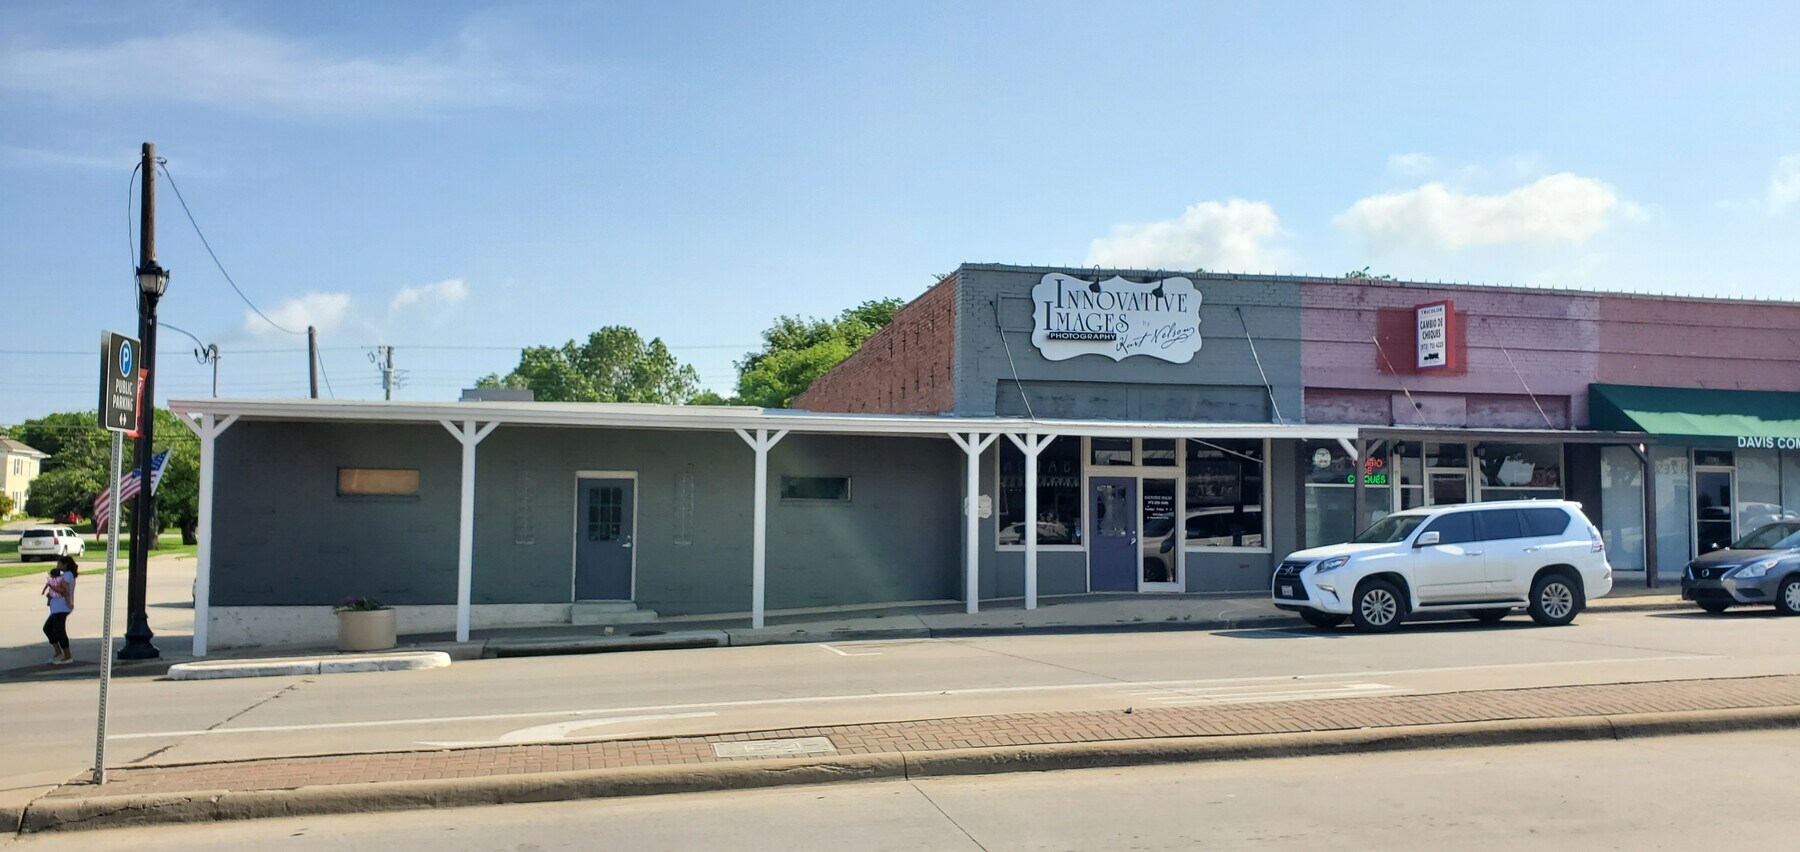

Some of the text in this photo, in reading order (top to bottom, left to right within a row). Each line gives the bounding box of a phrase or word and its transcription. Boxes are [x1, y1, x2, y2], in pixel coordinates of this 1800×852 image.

[1054, 279, 1188, 313] INNOVATIVE
[1043, 301, 1130, 333] IMAGES
[1420, 317, 1443, 330] CAMBIO DE
[1050, 332, 1117, 341] PHOTOGRAPHY
[1422, 329, 1441, 340] CHEQUES
[122, 347, 130, 372] P
[115, 378, 133, 395] PUBLIC
[112, 394, 133, 411] PARKING
[1737, 436, 1774, 448] DAVIS
[1347, 474, 1386, 484] CQUES
